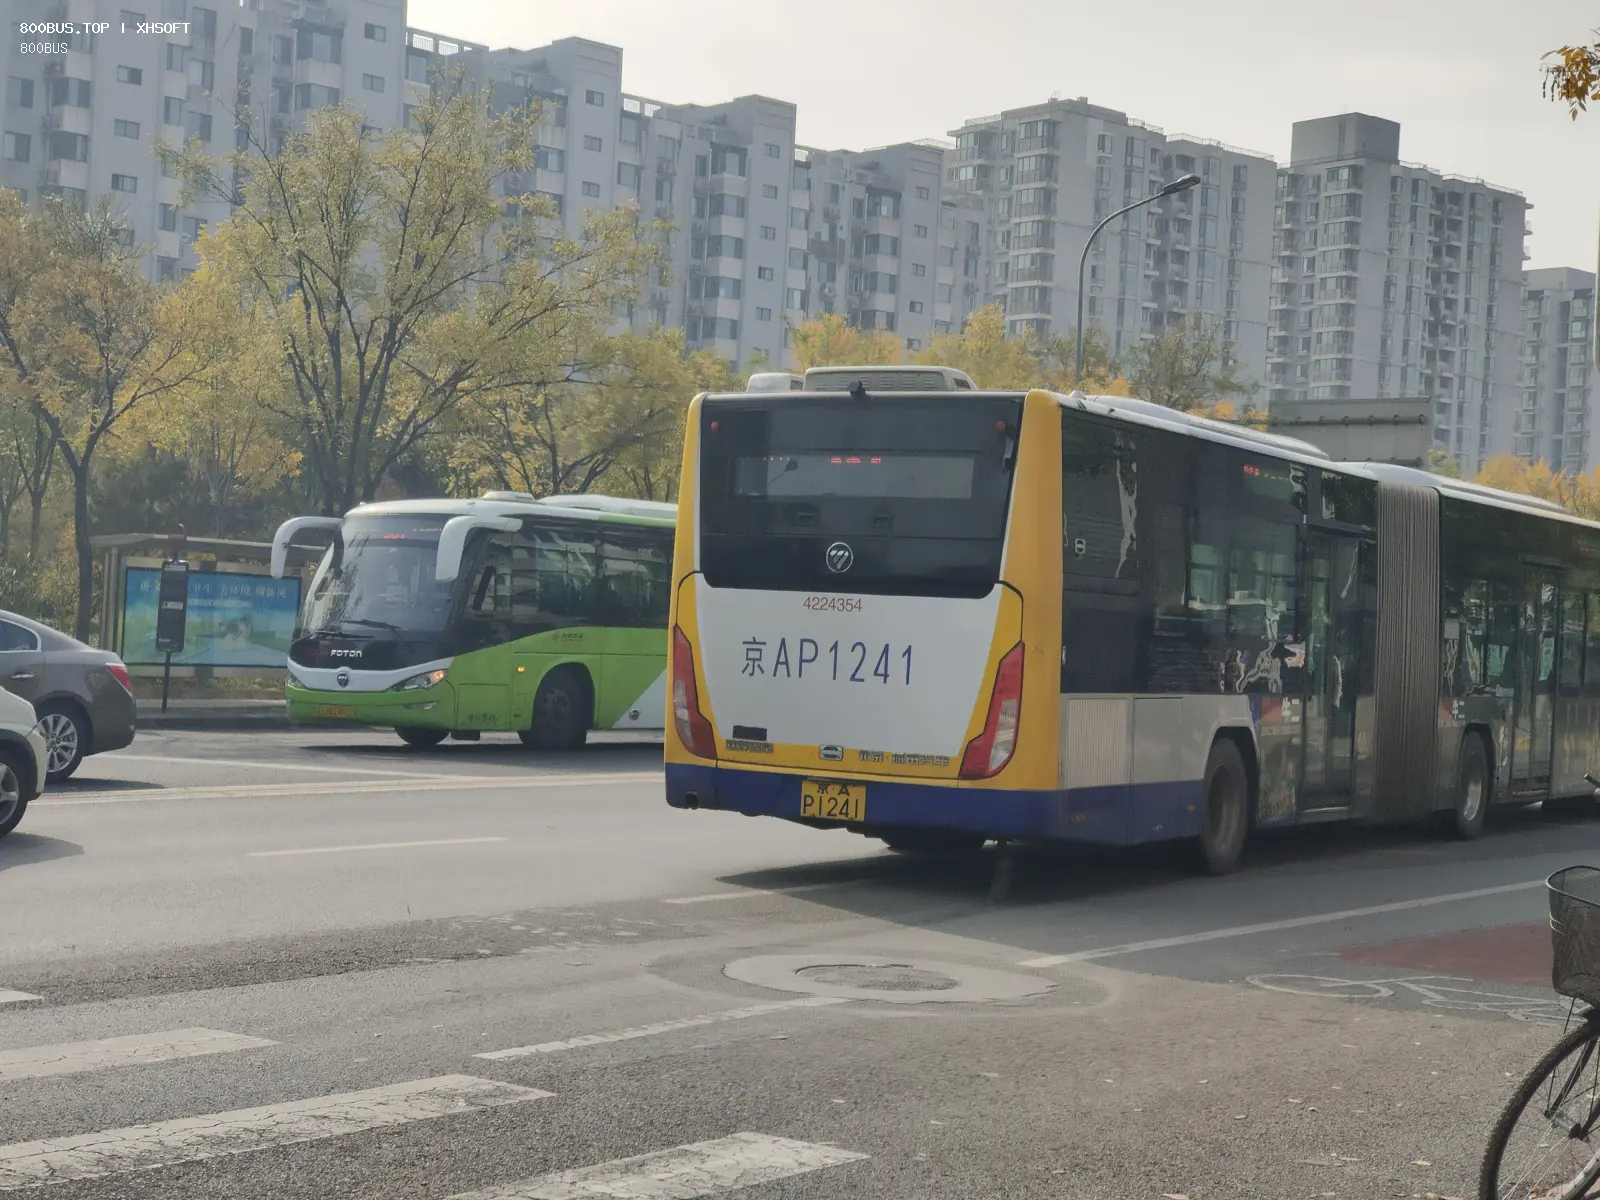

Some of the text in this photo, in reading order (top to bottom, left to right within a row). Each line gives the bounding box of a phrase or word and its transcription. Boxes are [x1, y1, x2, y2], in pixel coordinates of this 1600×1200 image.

[803, 595, 862, 612] 4224354
[330, 649, 362, 657] FOTON
[742, 636, 912, 685] 京AP1241
[803, 794, 858, 818] P1241
